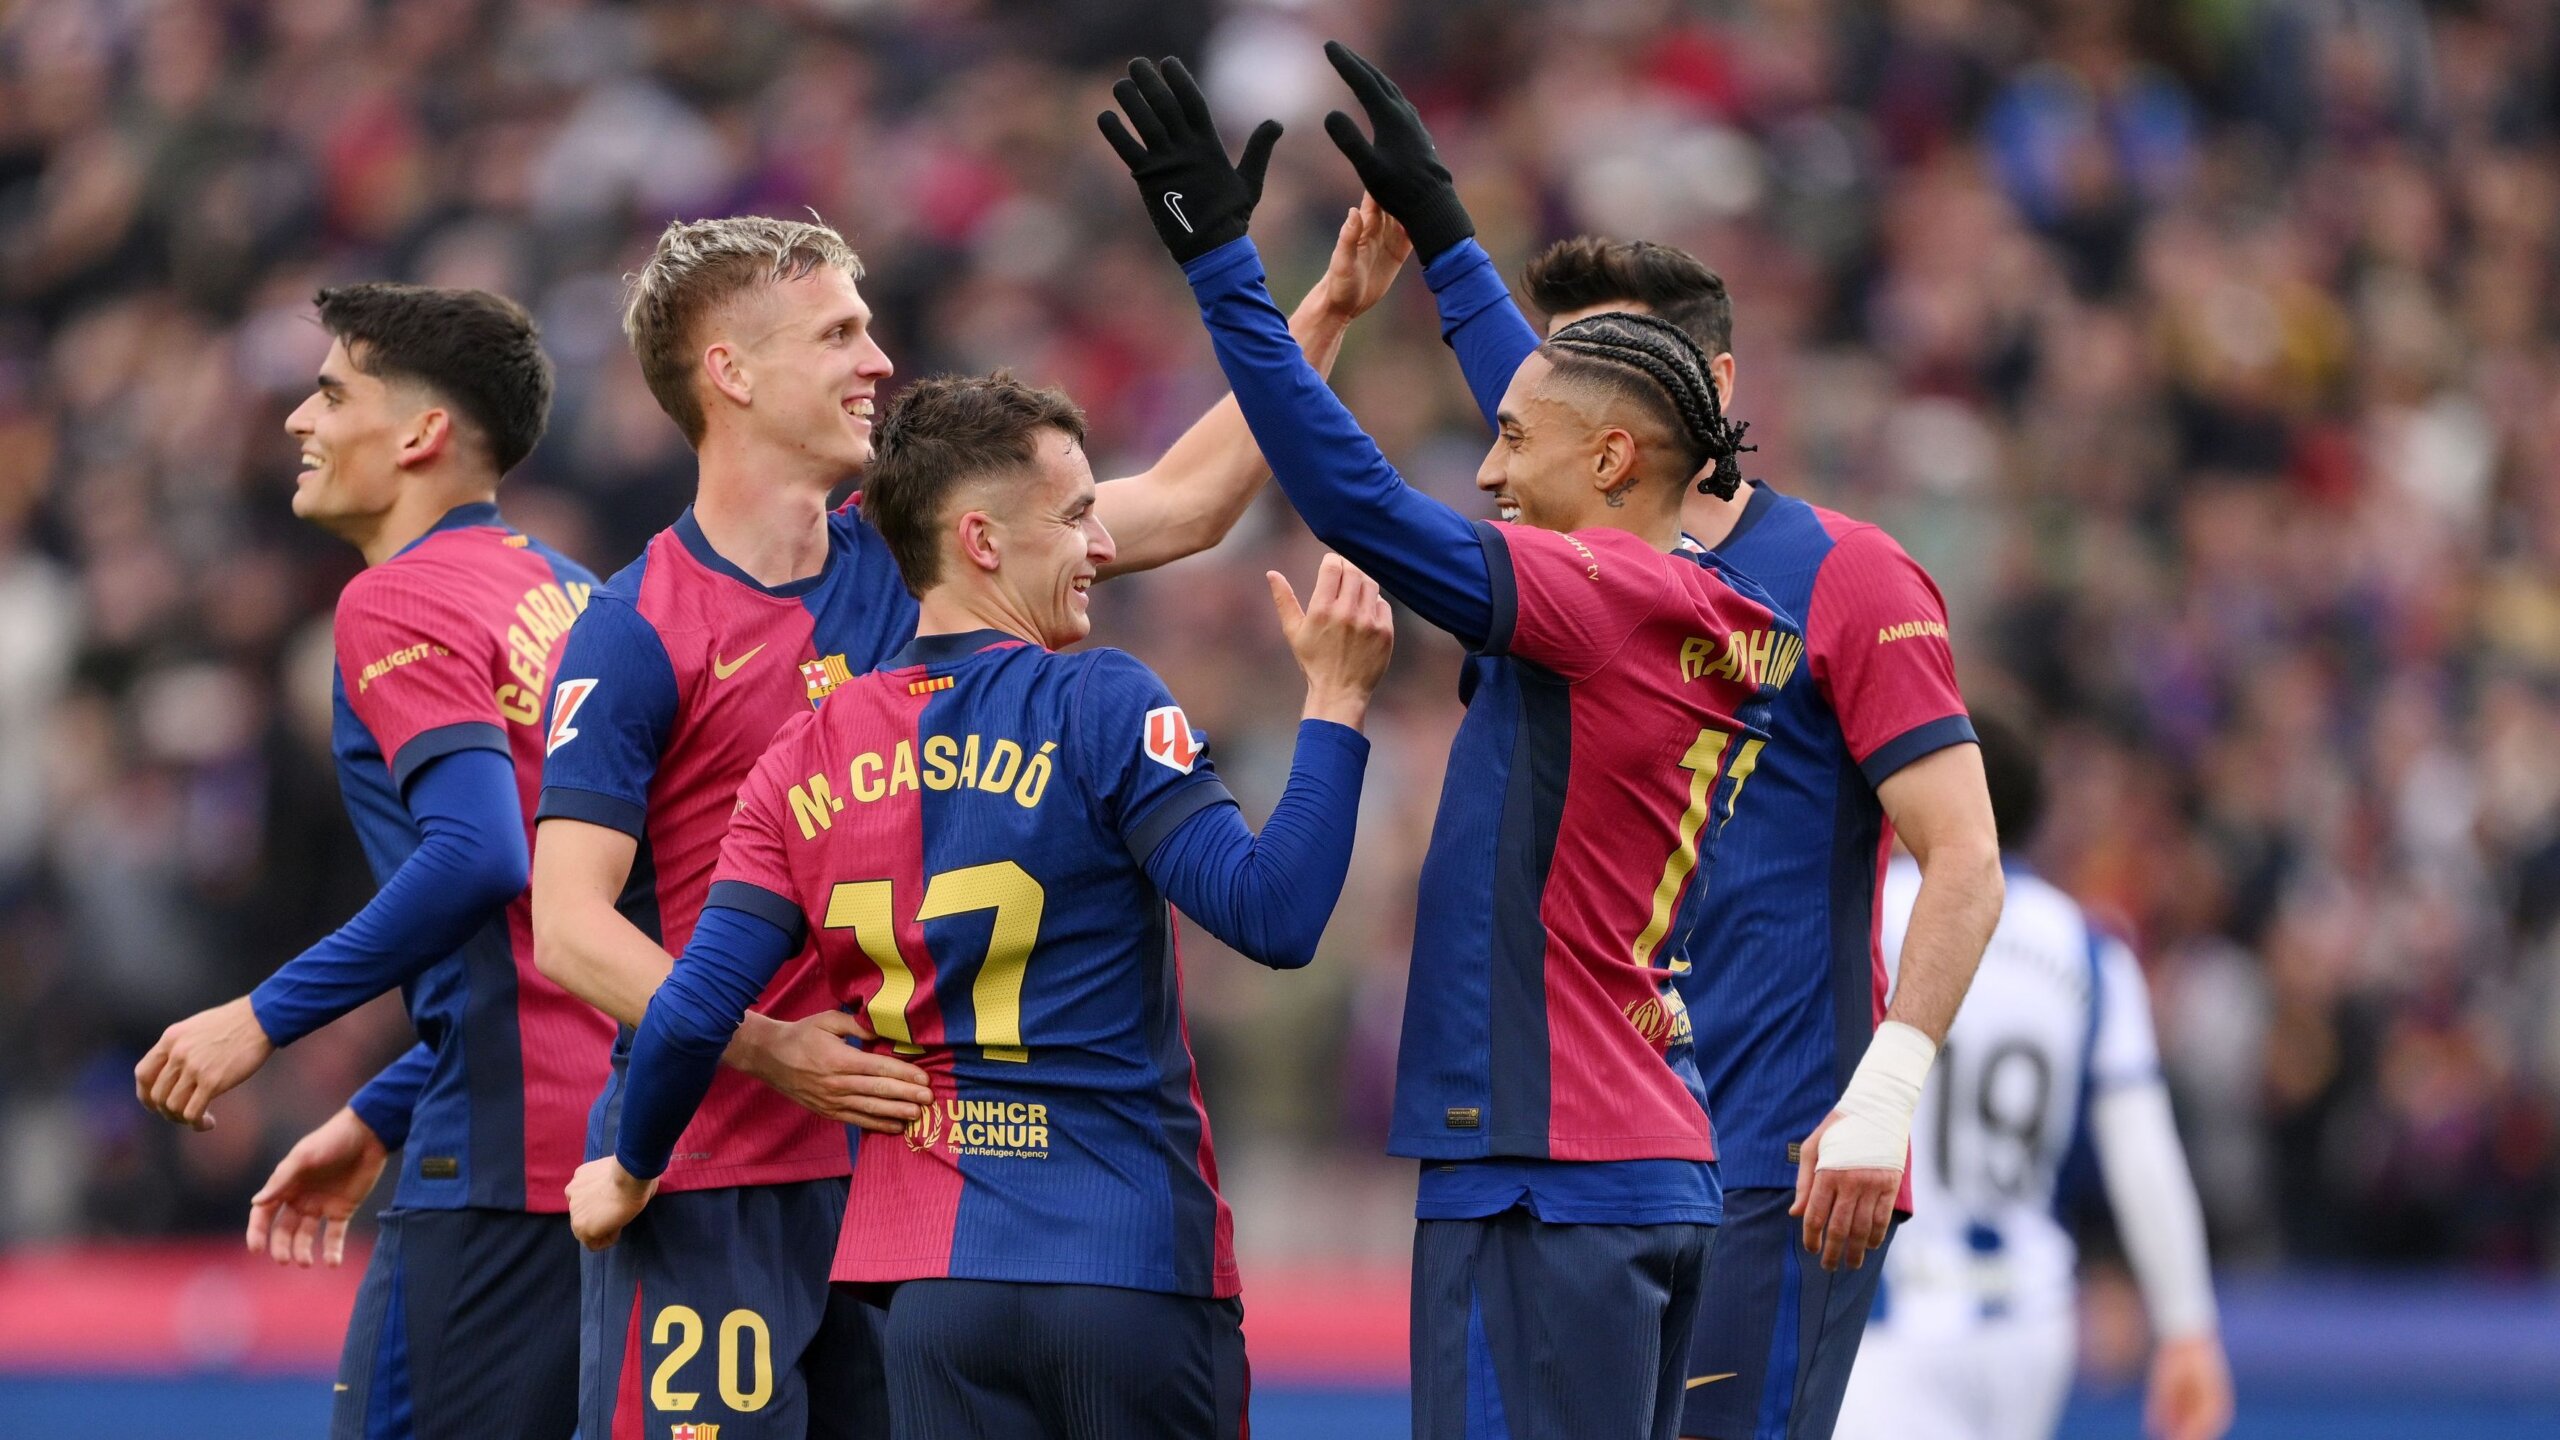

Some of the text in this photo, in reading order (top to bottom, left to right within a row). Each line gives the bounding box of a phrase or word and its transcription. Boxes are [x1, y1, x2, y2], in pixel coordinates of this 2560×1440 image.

[787, 734, 1058, 841] M. CASADÓ
[1632, 728, 1767, 972] 11
[822, 858, 1045, 1064] 17
[946, 1099, 1048, 1125] UNHCR
[946, 1122, 1048, 1148] ACNUR
[948, 1145, 1049, 1160] The UN Refugee Agency
[1934, 1038, 2051, 1195] 19
[650, 1304, 773, 1412] 20
